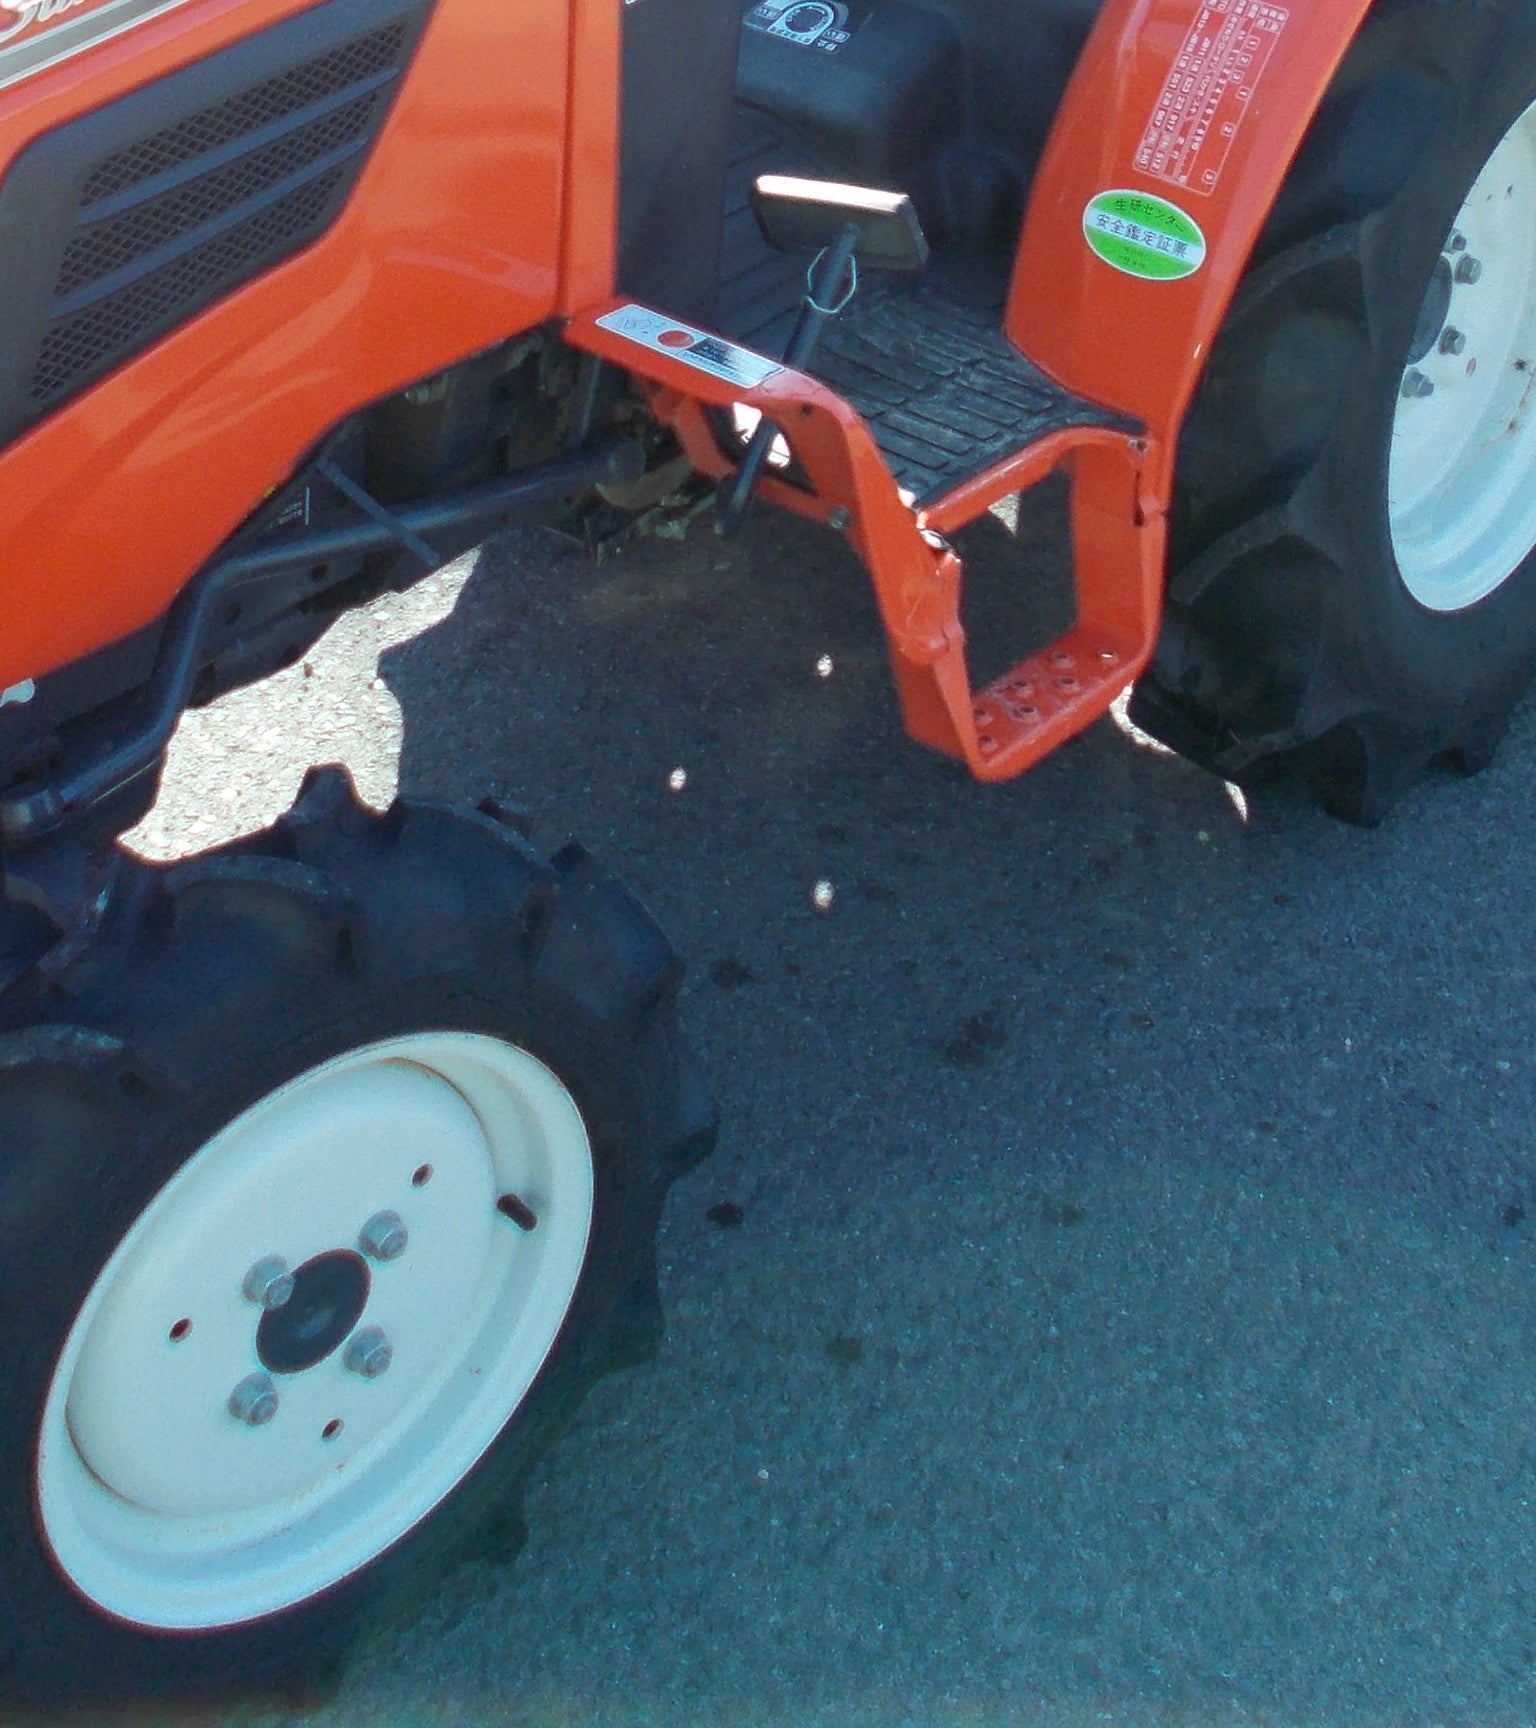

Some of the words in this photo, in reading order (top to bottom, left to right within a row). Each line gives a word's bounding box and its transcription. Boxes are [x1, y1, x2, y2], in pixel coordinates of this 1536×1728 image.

[1115, 198, 1184, 232] 生研センター
[1096, 213, 1188, 257] 安全鑑定証票
